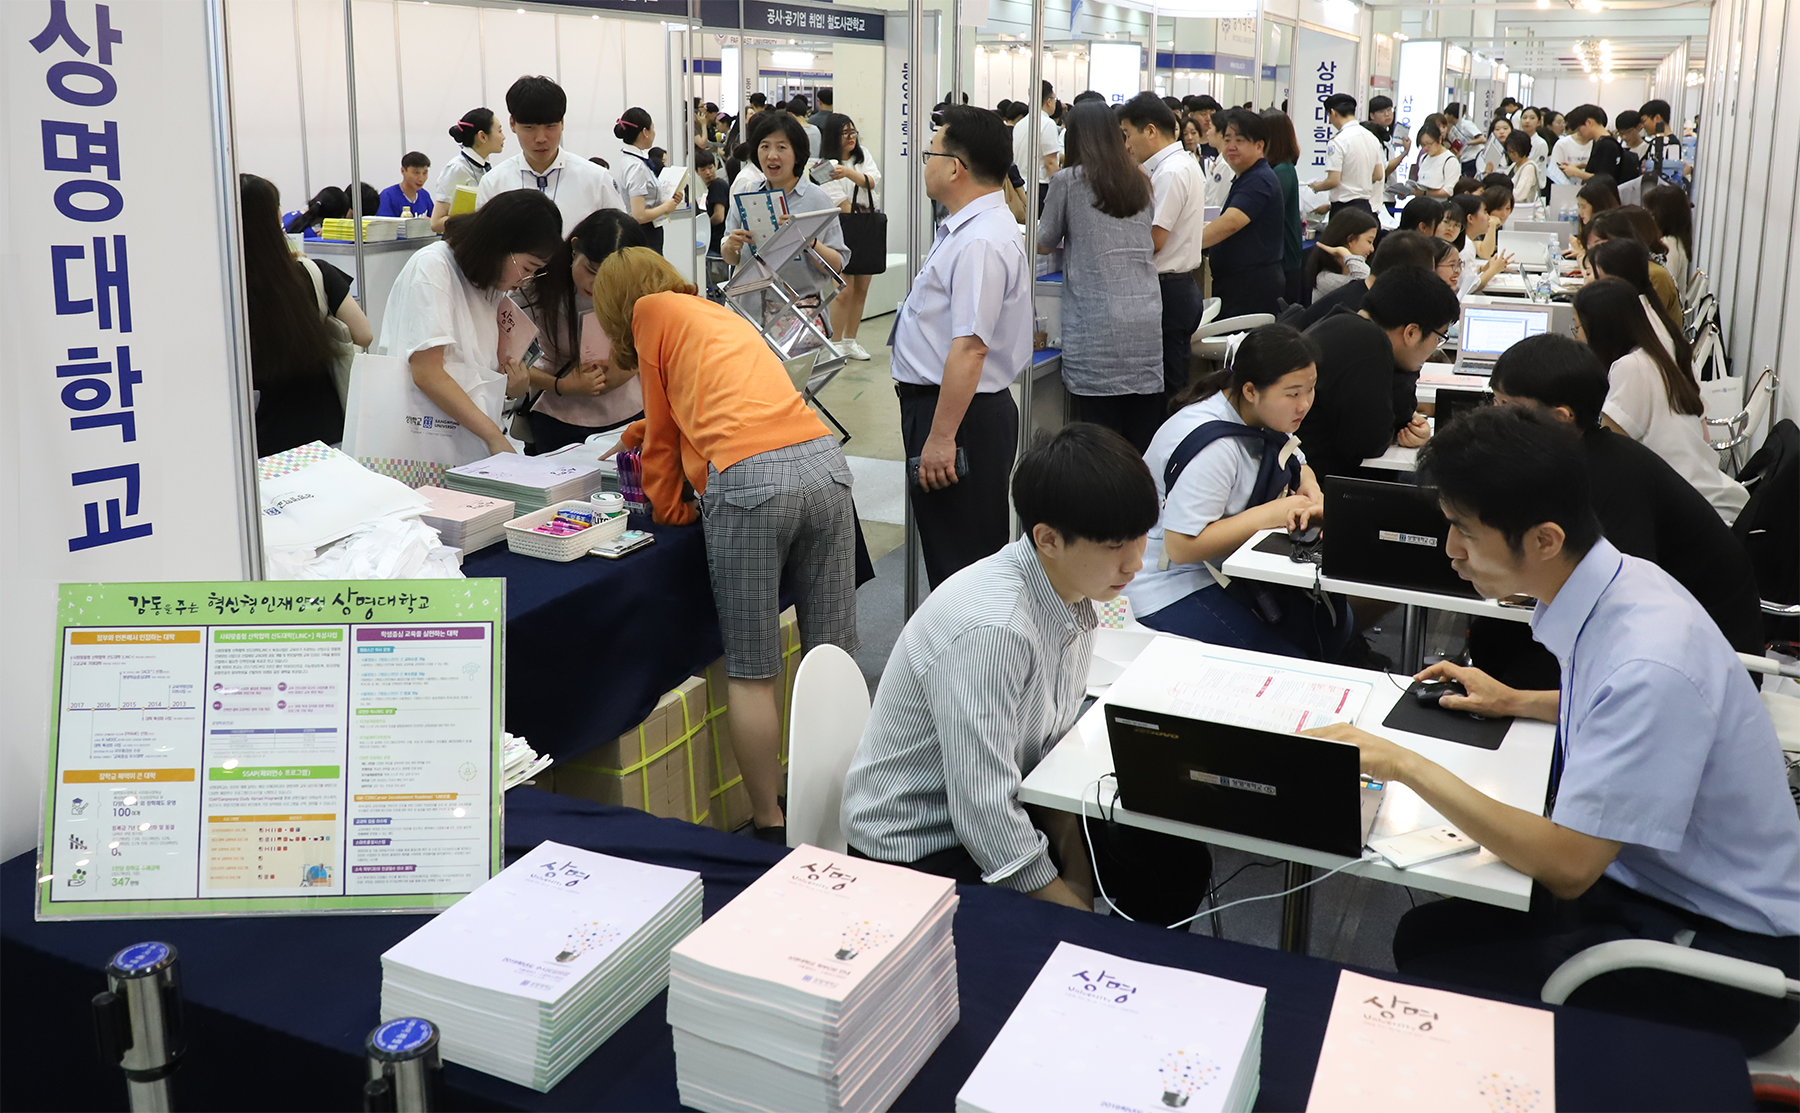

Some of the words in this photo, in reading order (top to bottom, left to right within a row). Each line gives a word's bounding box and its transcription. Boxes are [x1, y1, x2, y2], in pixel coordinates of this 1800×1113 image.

[766, 8, 807, 28] 공사·공기업
[808, 11, 826, 30] 취업!
[827, 14, 866, 32] 철도사관학교
[29, 0, 153, 552] 상명대학교
[500, 310, 516, 334] 상명
[128, 596, 174, 615] 감동을
[176, 599, 200, 616] 주는
[208, 592, 258, 614] 혁신형
[261, 596, 326, 612] 인재양성
[332, 587, 430, 620] 상명대학교
[540, 860, 590, 887] 상명
[800, 862, 857, 890] 상명
[1068, 984, 1112, 1003] University
[1072, 970, 1138, 1004] 상명
[1362, 994, 1440, 1032] 상명
[1362, 1013, 1418, 1032] University
